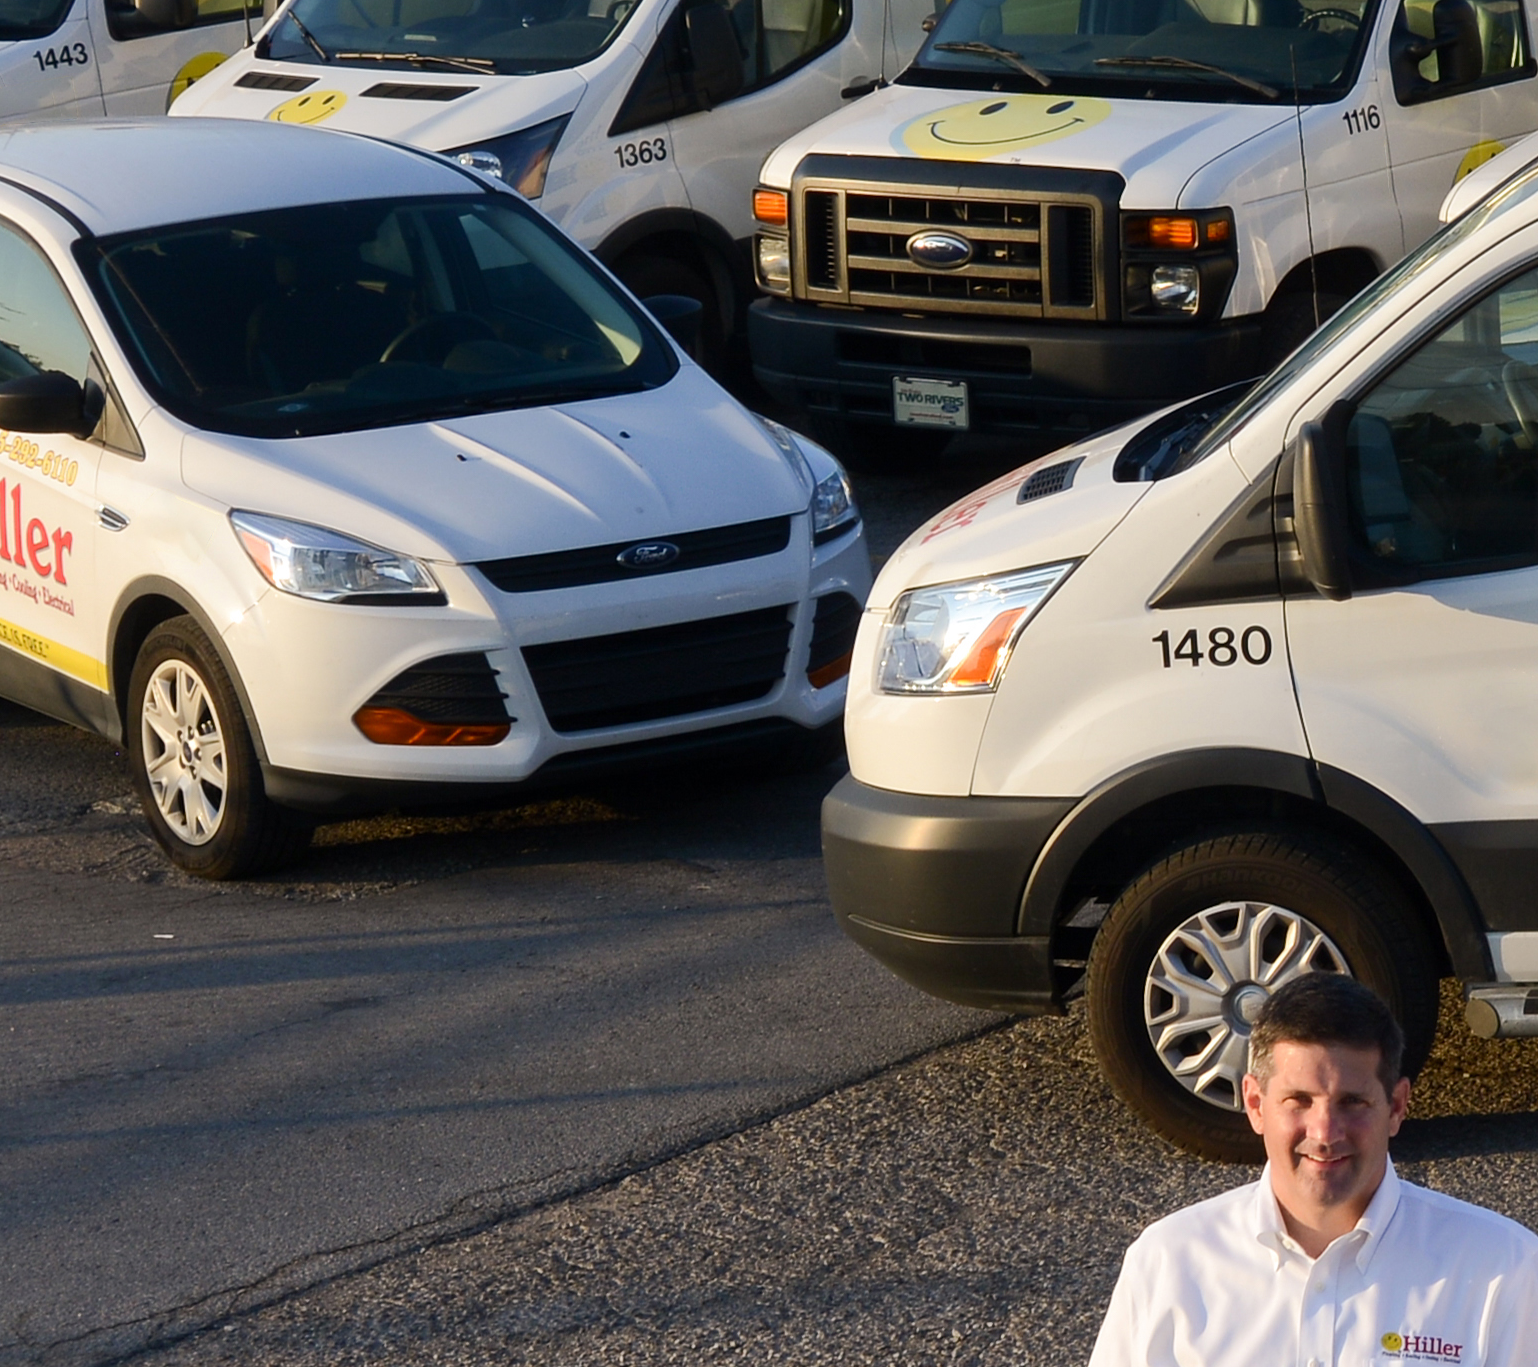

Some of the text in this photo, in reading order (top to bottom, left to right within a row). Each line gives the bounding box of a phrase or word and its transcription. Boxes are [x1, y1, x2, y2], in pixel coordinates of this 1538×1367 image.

[33, 42, 89, 72] 1443
[1342, 104, 1381, 137] 1116
[613, 137, 668, 170] 1363
[897, 393, 964, 406] TWO RIVERS
[634, 545, 668, 565] Ford
[1151, 624, 1273, 669] 1480
[1403, 1335, 1463, 1358] Hiller
